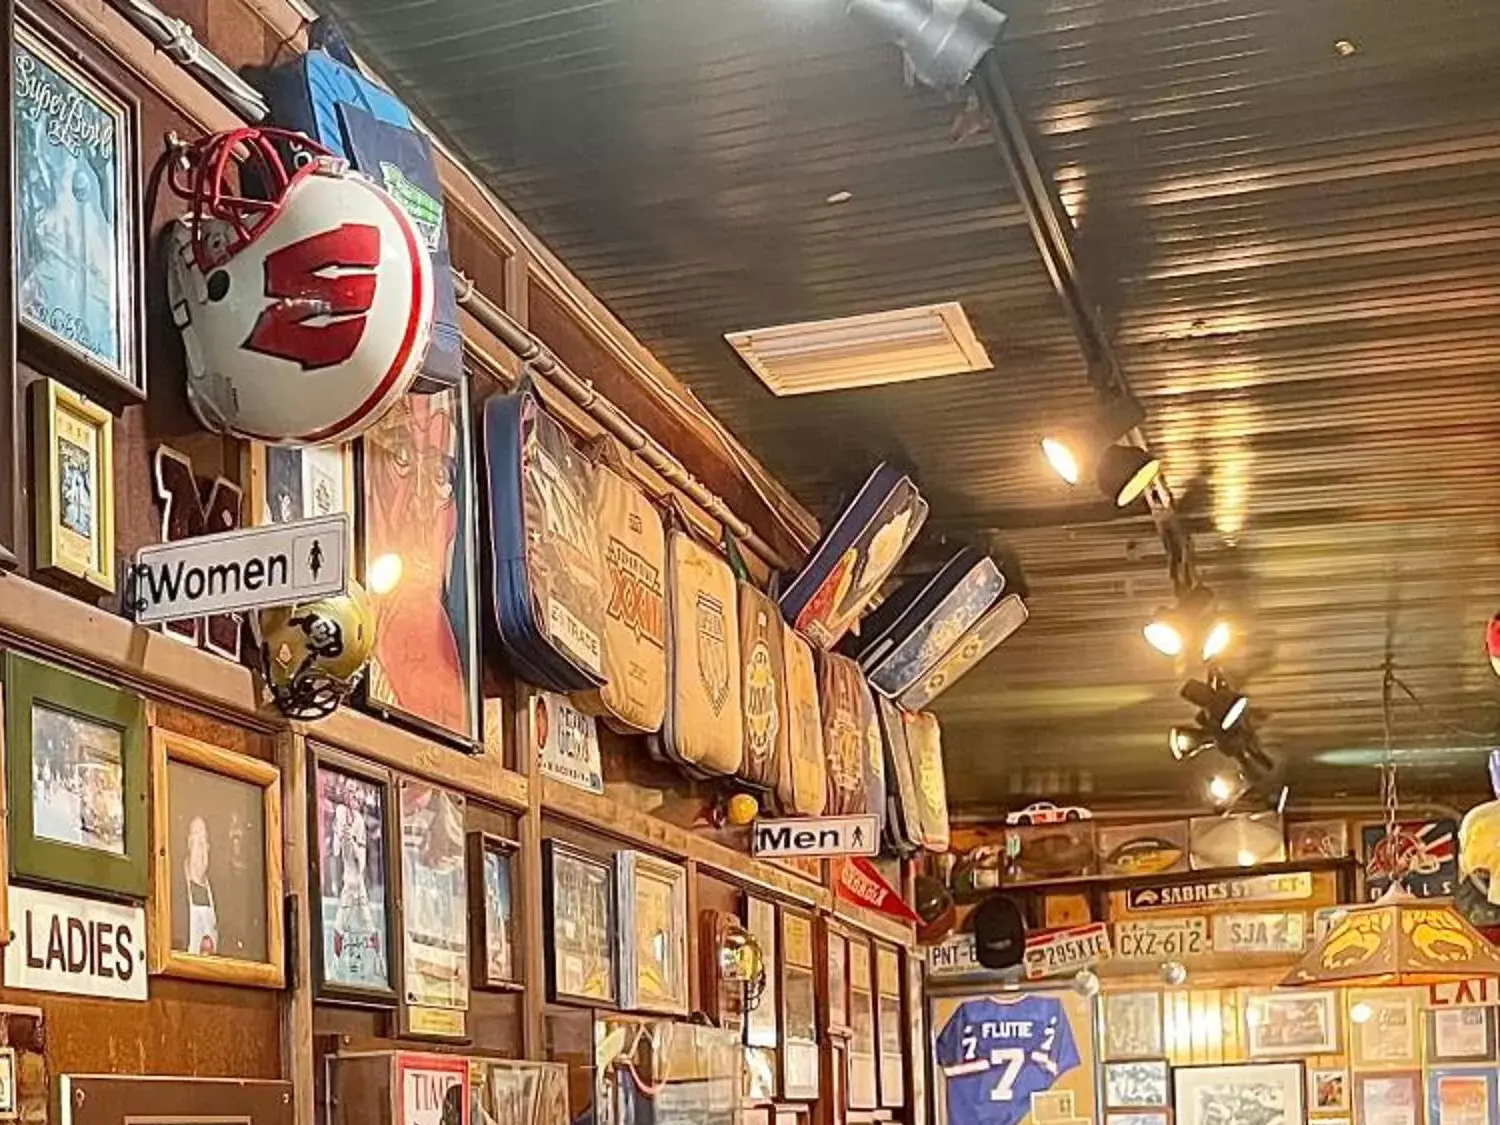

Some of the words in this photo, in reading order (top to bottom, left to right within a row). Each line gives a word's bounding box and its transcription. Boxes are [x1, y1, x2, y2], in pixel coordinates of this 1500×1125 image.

[148, 553, 287, 604] Women
[760, 828, 839, 850] Men
[1161, 882, 1227, 903] SABRES
[25, 910, 133, 981] LADIES
[982, 1022, 1033, 1038] FLUTIE
[962, 1037, 977, 1059] 7
[990, 1048, 1024, 1100] 7
